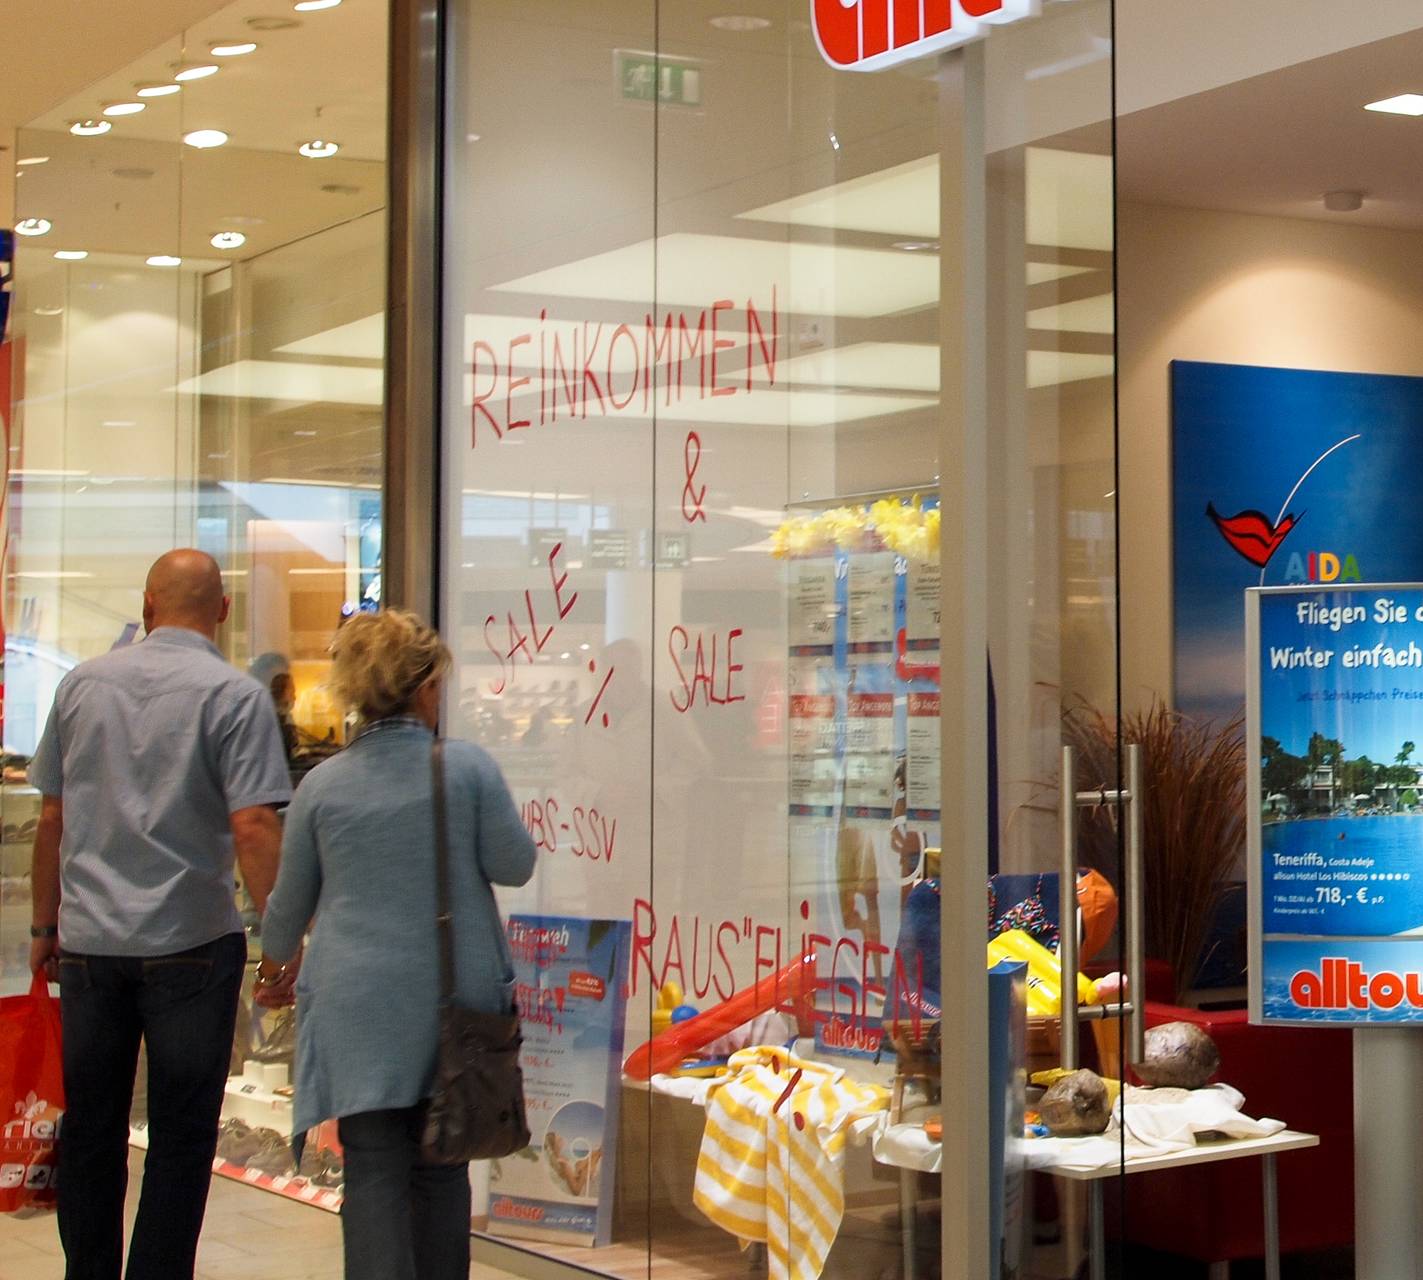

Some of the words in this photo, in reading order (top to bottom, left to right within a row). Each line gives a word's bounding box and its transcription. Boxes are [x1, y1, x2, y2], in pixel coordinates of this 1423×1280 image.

[682, 430, 706, 523] &
[1283, 552, 1362, 582] AIDA
[483, 541, 578, 695] SALE
[1296, 602, 1367, 632] Fliegen
[1373, 598, 1408, 624] Sie
[668, 625, 745, 713] SALE
[1270, 646, 1335, 670] Winter
[1342, 641, 1423, 668] einfach
[1273, 852, 1328, 868] Teneriffa,
[1315, 887, 1353, 906] 718,-
[1356, 887, 1369, 904] €
